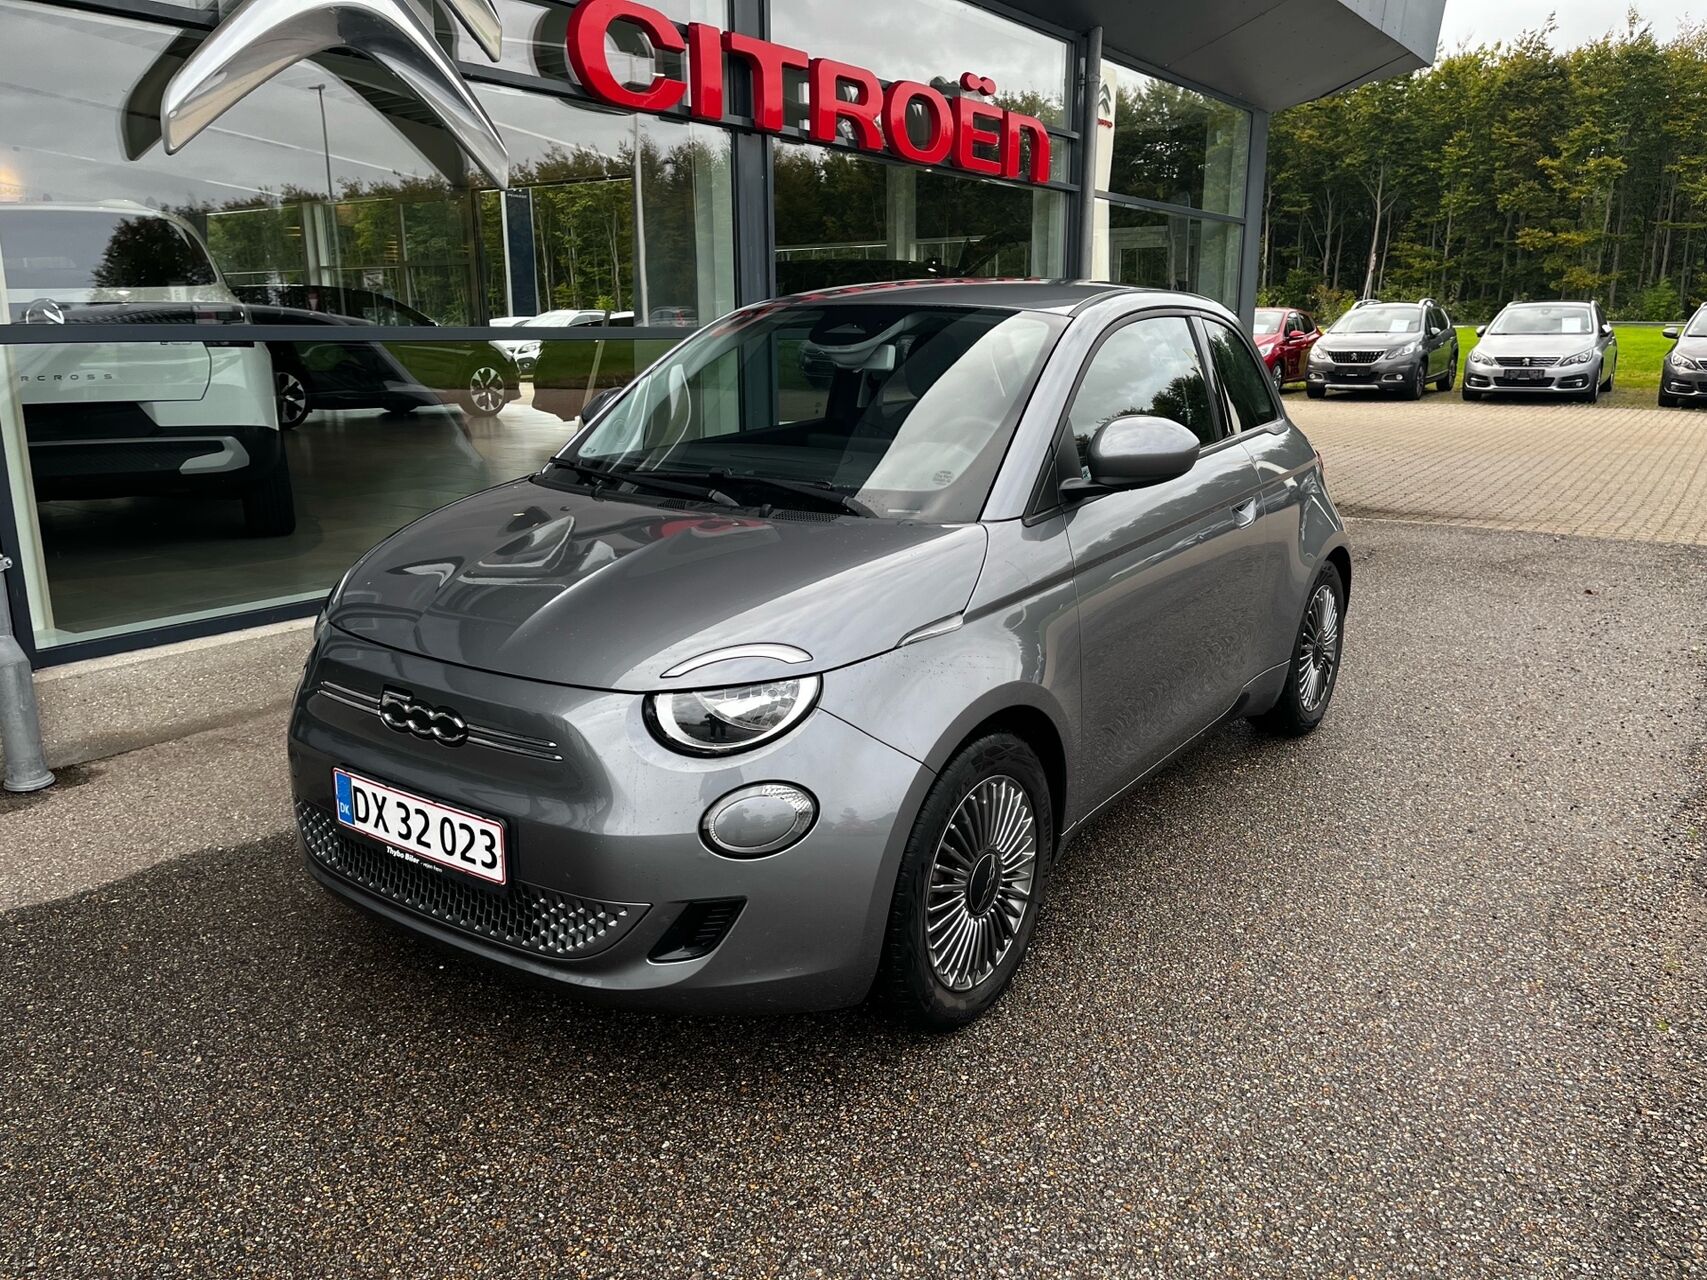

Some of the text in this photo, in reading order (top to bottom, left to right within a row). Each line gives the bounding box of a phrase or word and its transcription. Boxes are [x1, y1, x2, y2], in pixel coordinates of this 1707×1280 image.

[20, 373, 113, 382] RCROSS
[381, 685, 468, 747] 500
[340, 802, 350, 815] DK
[353, 785, 498, 869] DX 32 023
